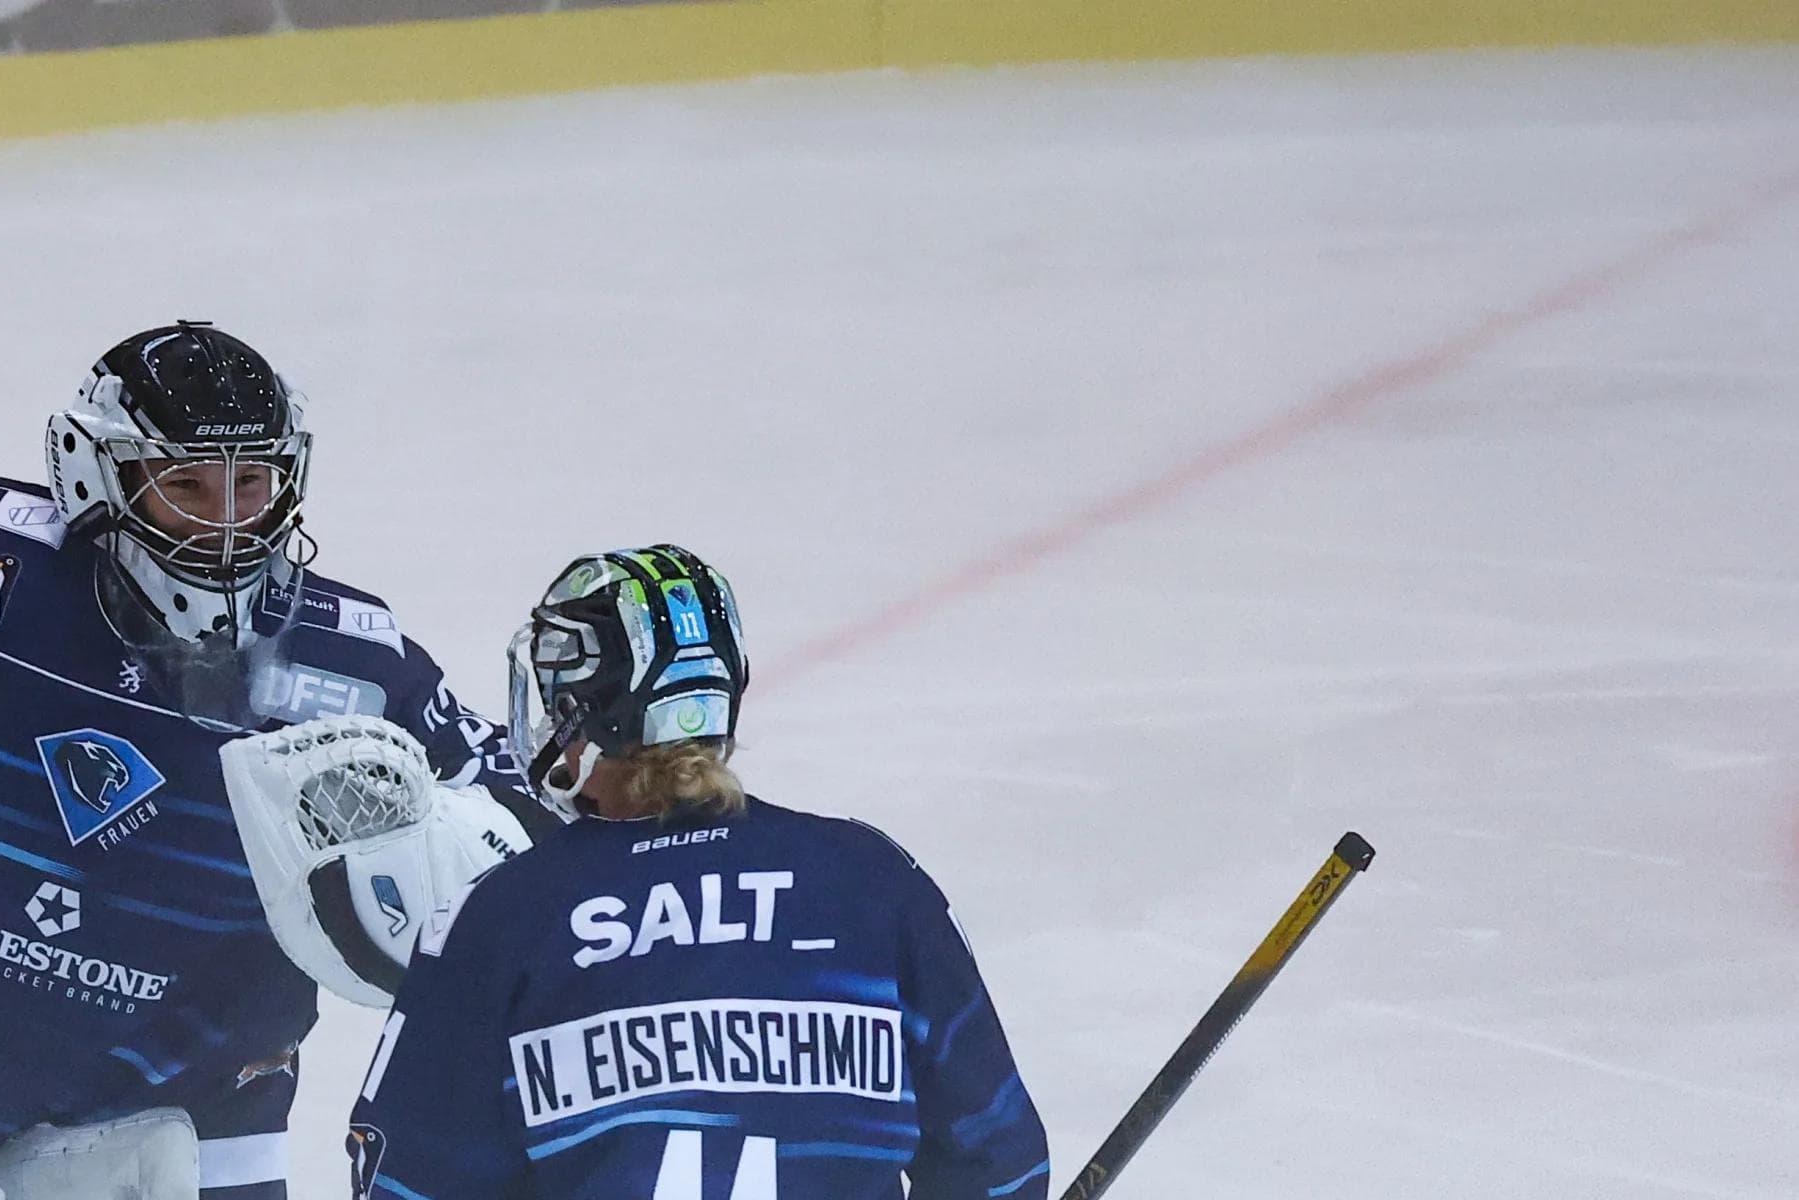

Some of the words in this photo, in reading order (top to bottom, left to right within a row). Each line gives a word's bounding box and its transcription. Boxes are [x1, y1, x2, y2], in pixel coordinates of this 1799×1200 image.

[680, 611, 701, 639] 11
[96, 799, 160, 852] FRAUEN
[66, 985, 137, 1015] BRAND
[522, 1038, 573, 1116] N.
[583, 1008, 895, 1101] EISENSCHMID
